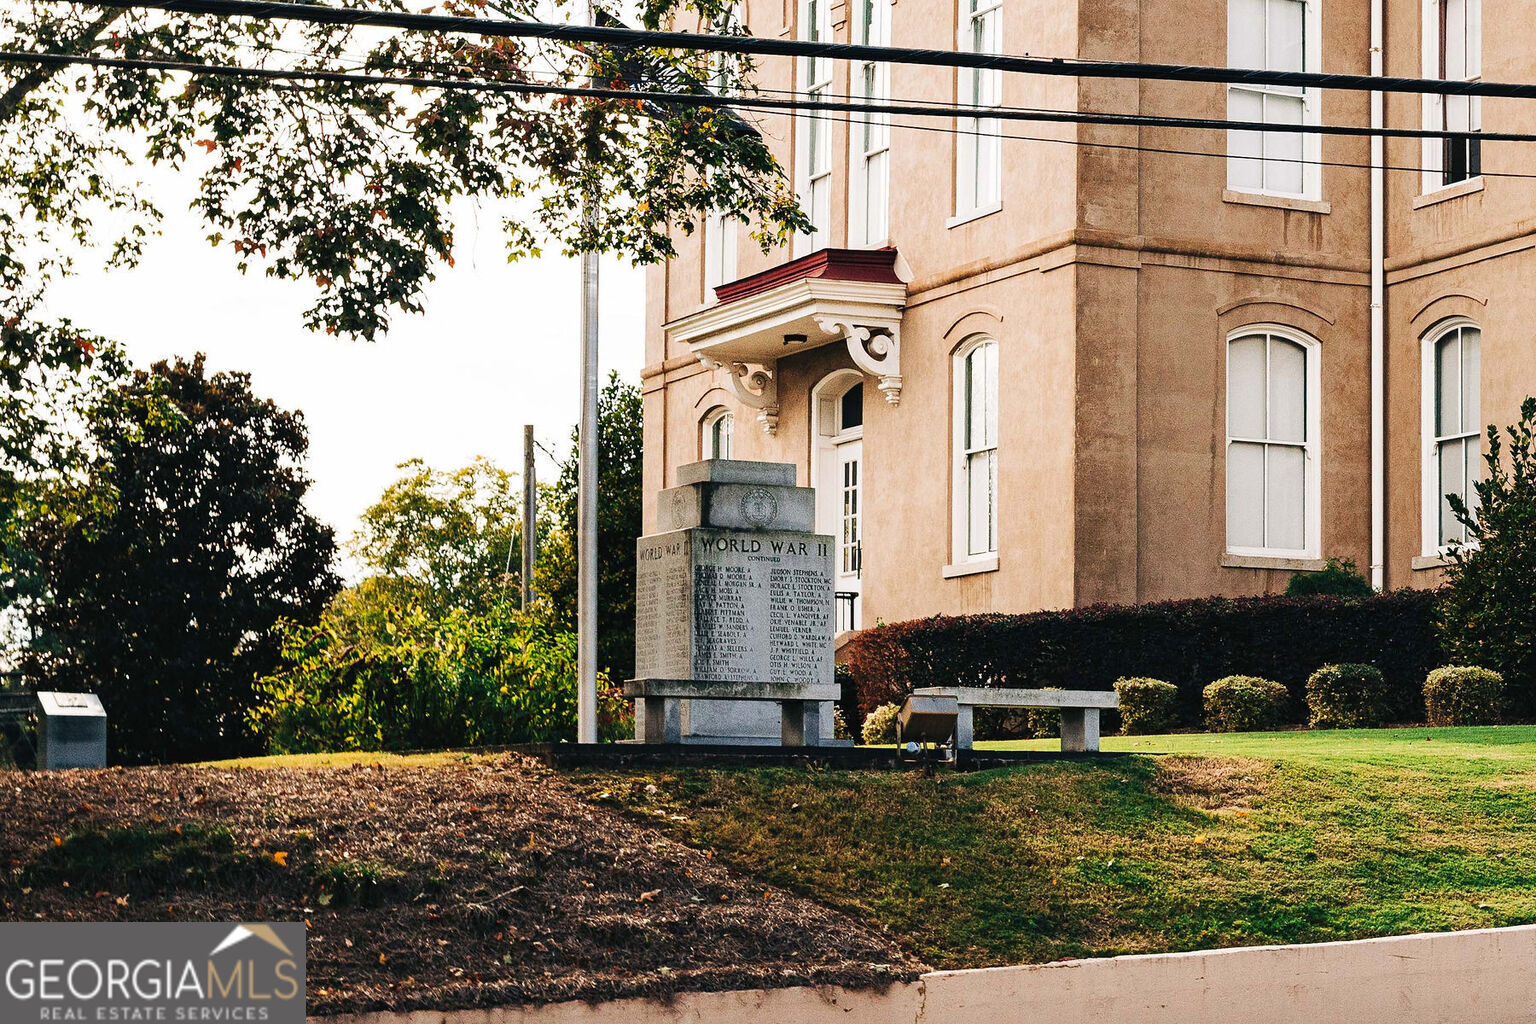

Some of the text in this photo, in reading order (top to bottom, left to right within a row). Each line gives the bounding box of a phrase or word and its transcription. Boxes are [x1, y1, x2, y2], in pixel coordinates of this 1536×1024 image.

[639, 547, 663, 560] WORLD
[666, 543, 681, 555] WAR
[701, 537, 827, 556] WORLD WAR II
